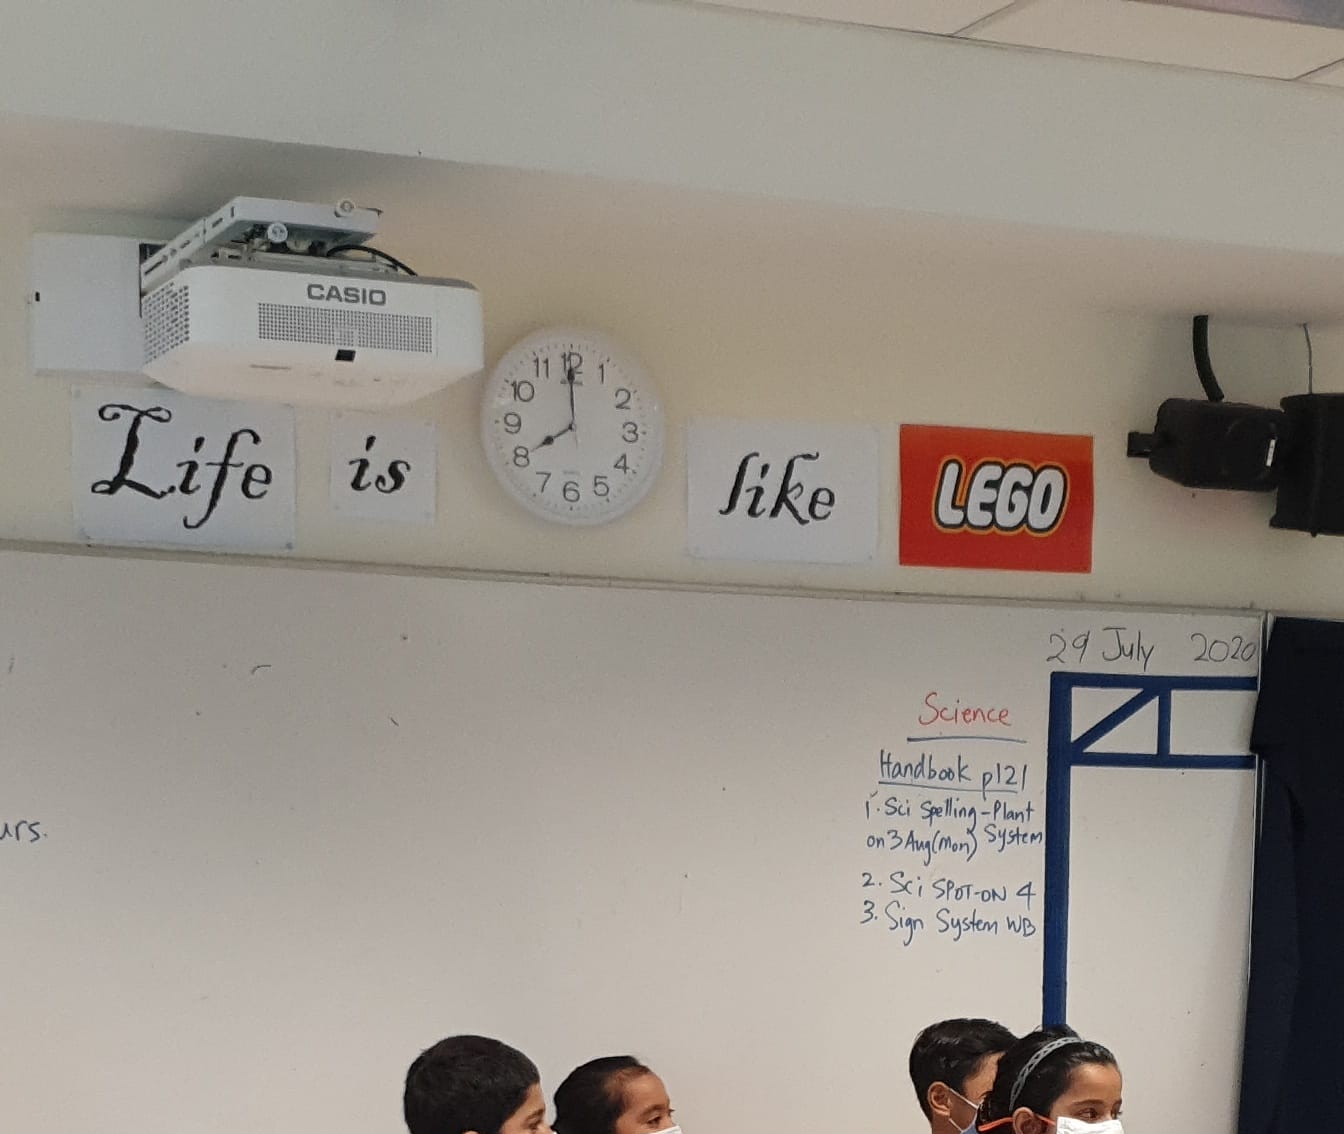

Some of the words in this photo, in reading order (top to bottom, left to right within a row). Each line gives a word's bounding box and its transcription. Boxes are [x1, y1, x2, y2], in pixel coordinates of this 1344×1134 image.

[307, 283, 387, 307] CASIO
[532, 358, 550, 379] 11
[560, 352, 583, 374] 12
[511, 380, 535, 402] 10
[614, 388, 632, 410] 2
[503, 412, 522, 434] 9
[622, 421, 639, 443] 3
[91, 404, 273, 529] Life
[349, 435, 412, 494] is
[718, 451, 836, 526] like
[513, 446, 530, 468] 8
[613, 453, 630, 475] 4
[535, 471, 552, 493] 7
[562, 481, 580, 502] 6
[593, 475, 610, 497] 5
[935, 459, 1066, 534] LEGO
[1046, 631, 1090, 663] 29
[1100, 627, 1156, 671] July
[1190, 631, 1257, 663] 2020
[918, 691, 1012, 726] Science
[879, 749, 972, 782] Handbook
[982, 763, 1028, 801] p121
[884, 796, 911, 817] Sci
[983, 823, 1043, 853] System
[861, 872, 882, 887] 2.
[889, 871, 923, 897] Sci
[1015, 881, 1037, 910] 4
[859, 900, 878, 924] 3.
[884, 900, 924, 947] Sign
[936, 908, 998, 942] System
[1006, 915, 1037, 937] WB
